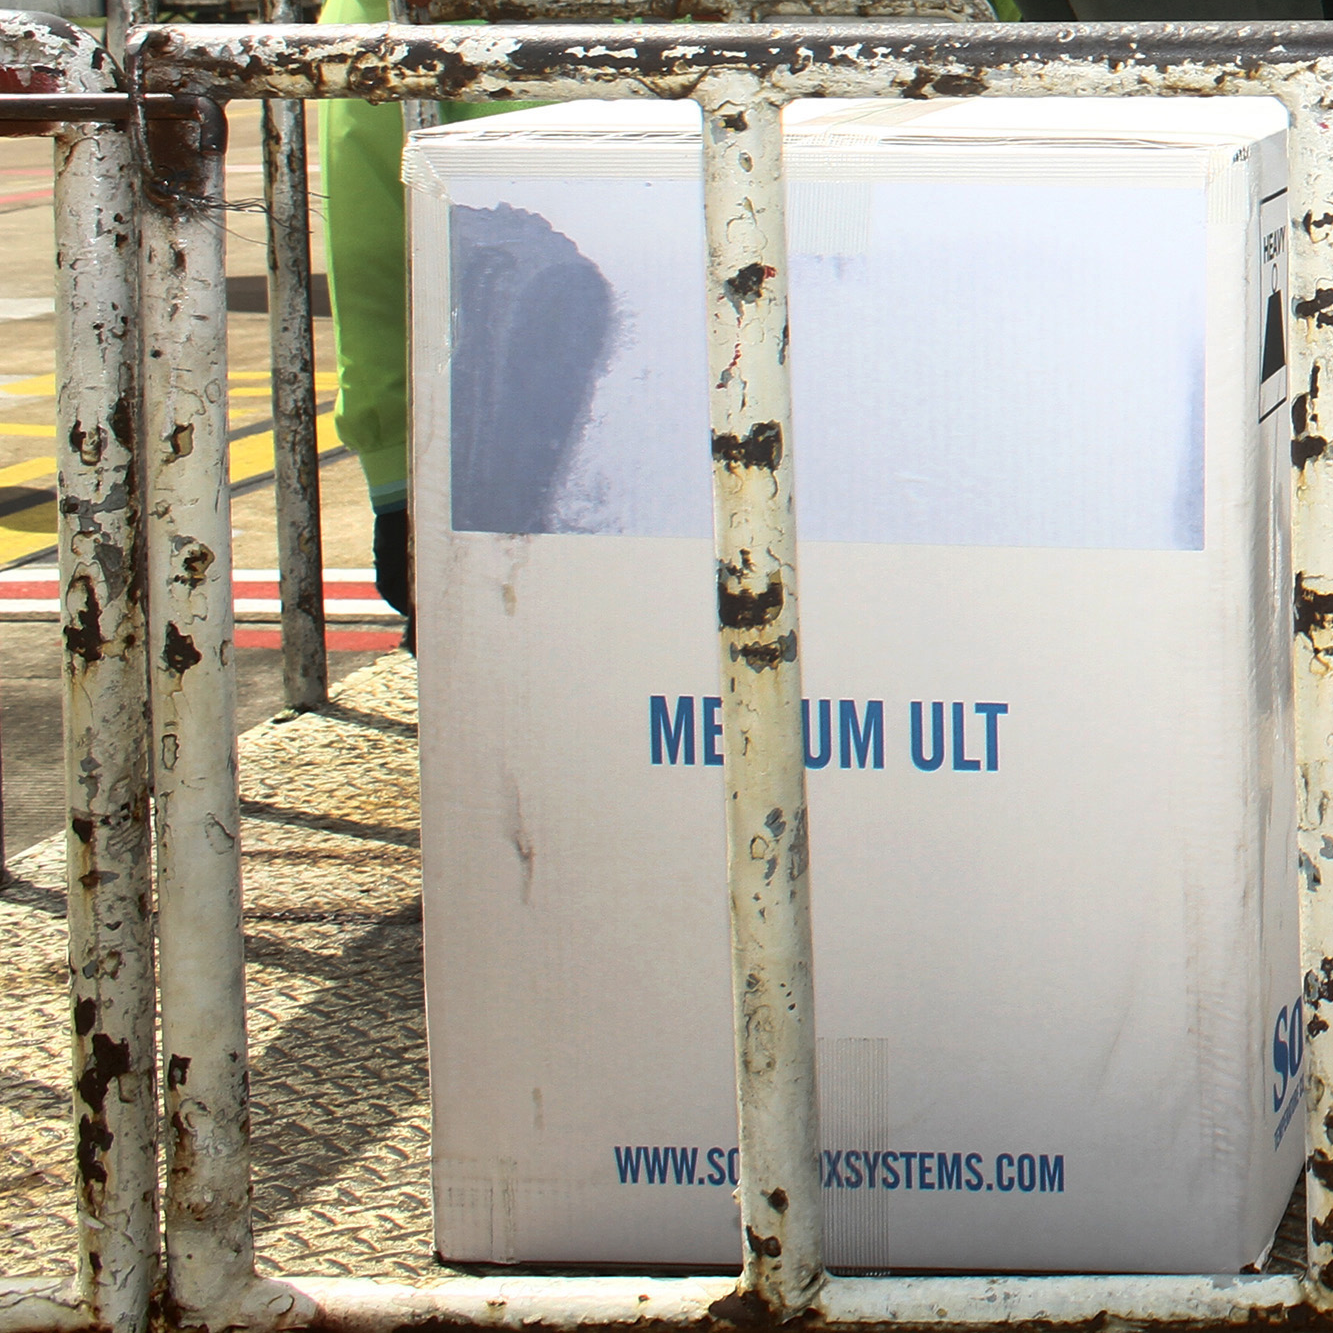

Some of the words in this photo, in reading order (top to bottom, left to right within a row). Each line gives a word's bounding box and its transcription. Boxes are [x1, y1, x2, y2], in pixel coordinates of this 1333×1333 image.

[1263, 226, 1286, 264] HEAVY
[649, 695, 885, 770] MEUM
[910, 700, 1009, 773] ULT
[614, 1145, 1066, 1194] WWW.SOXSYSTEMS.COM
